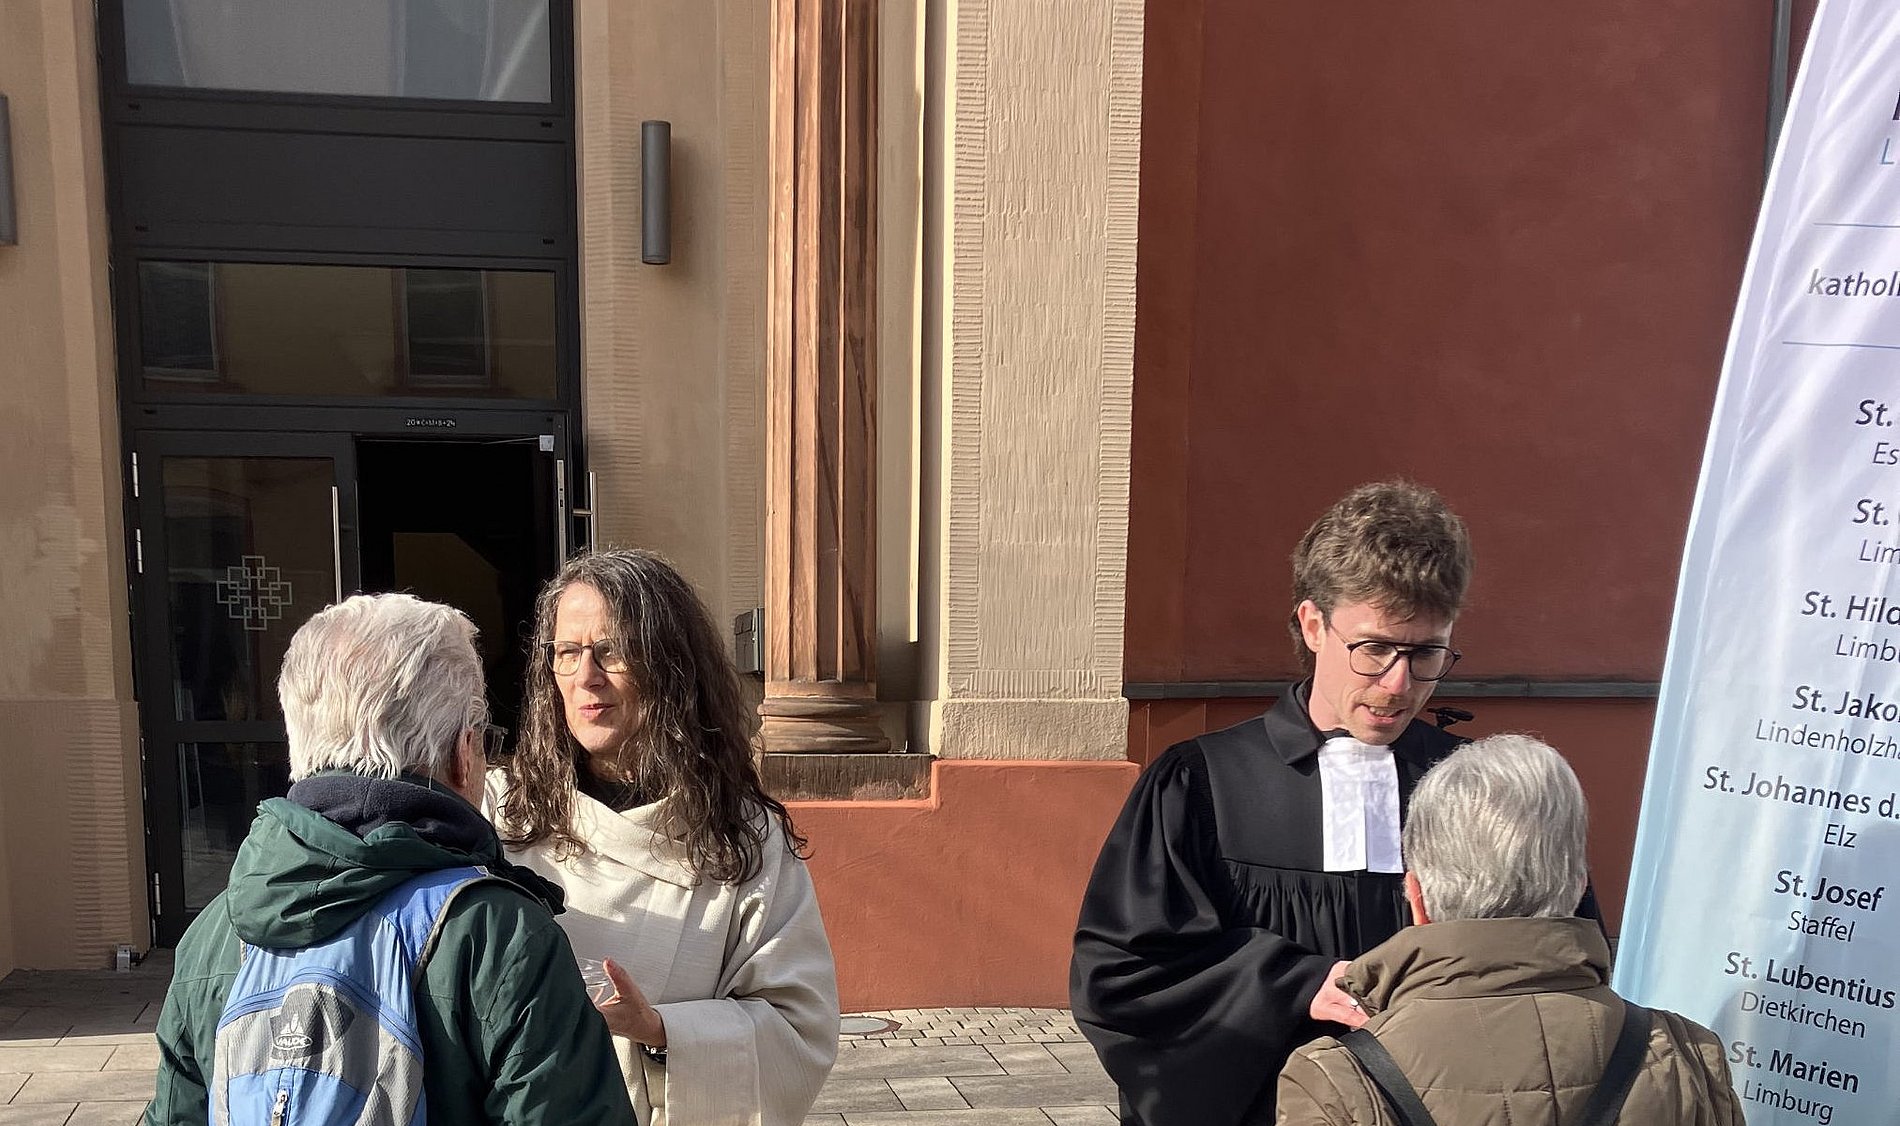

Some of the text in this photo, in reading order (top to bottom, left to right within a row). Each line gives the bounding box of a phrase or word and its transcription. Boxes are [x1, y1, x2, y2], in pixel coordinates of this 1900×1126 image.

[1855, 399, 1893, 427] St.
[1852, 498, 1889, 526] St.
[1801, 591, 1837, 618] St.
[1836, 634, 1900, 663] Limb
[1792, 685, 1900, 723] St. Jako
[1703, 766, 1900, 820] St. Johannes d.
[1823, 823, 1858, 849] Elz
[1774, 870, 1885, 912] St. Josef
[1788, 910, 1856, 943] Staffel
[1724, 951, 1897, 1009] St. Lubentius
[1740, 991, 1867, 1039] Dietkirchen
[1729, 1041, 1860, 1094] St. Marien
[1743, 1080, 1835, 1126] Limburg
